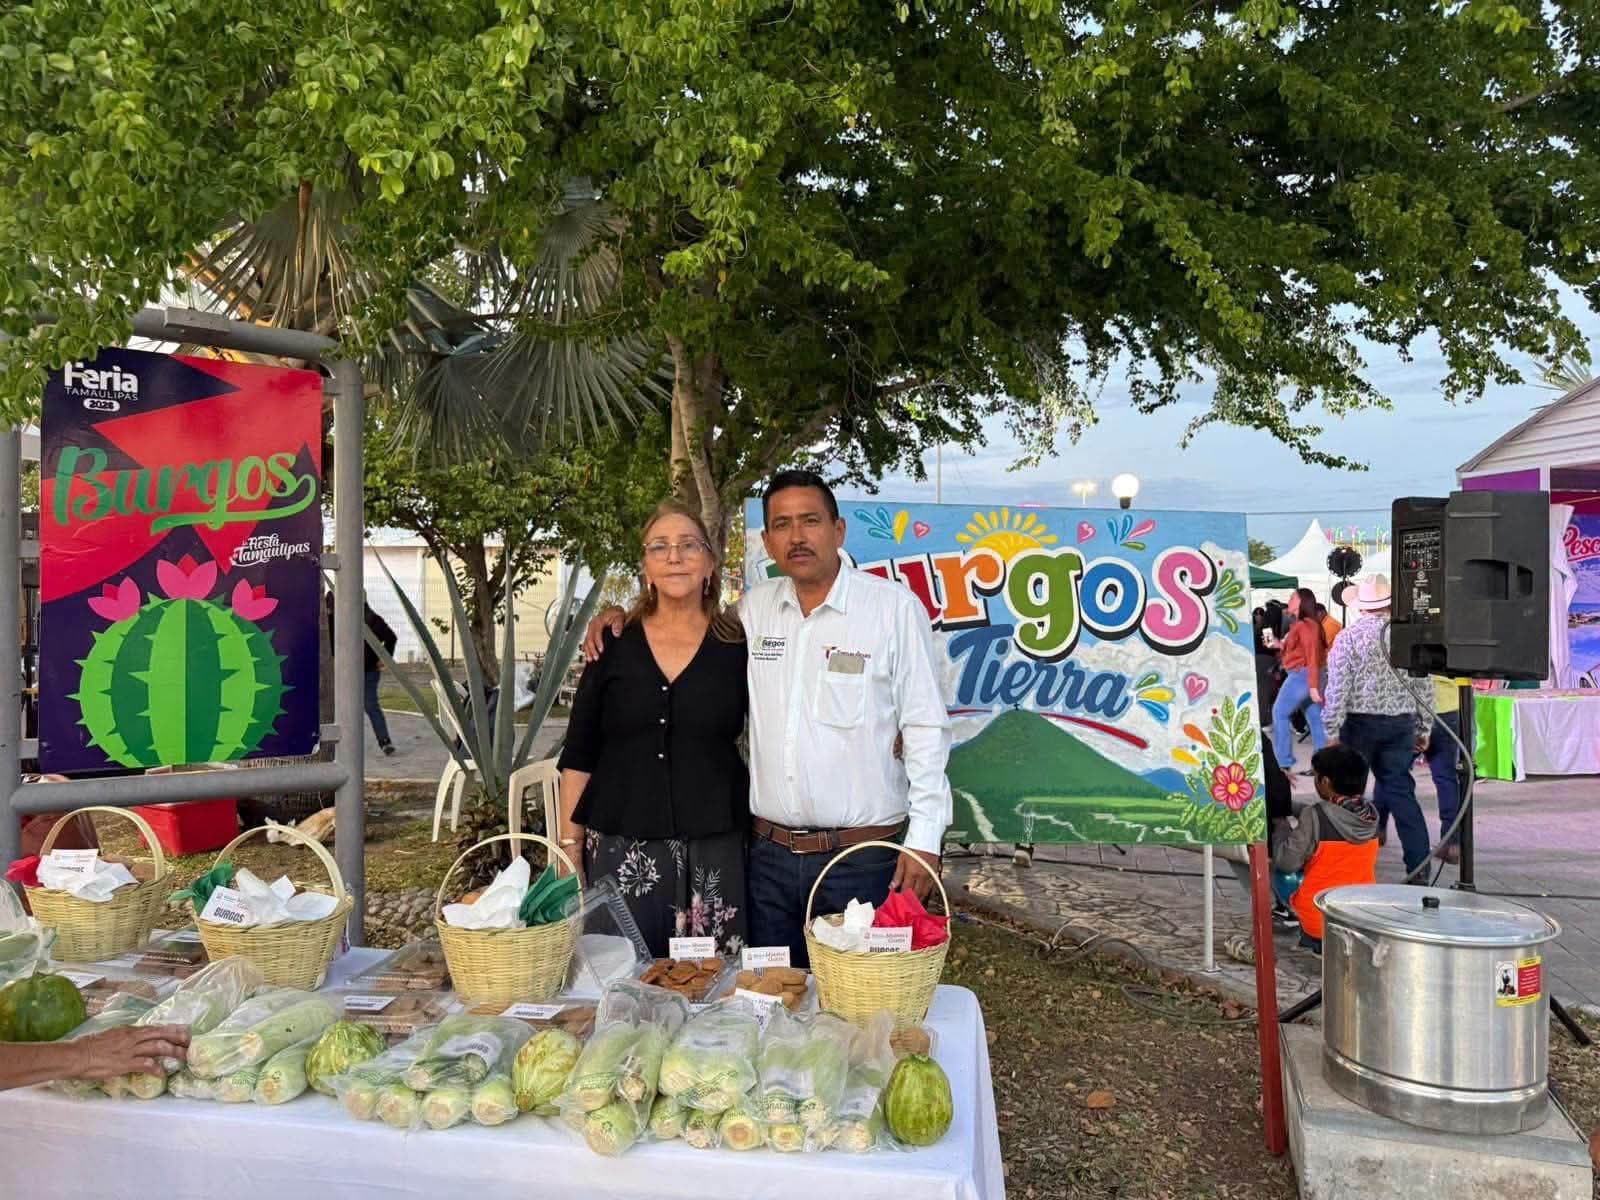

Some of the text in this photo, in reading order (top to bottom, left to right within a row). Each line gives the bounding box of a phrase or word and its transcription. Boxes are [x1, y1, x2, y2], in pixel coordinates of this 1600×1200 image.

[64, 361, 138, 393] Feria
[64, 387, 138, 401] TAMAULIPAS
[52, 446, 316, 536] Burgos
[248, 533, 280, 550] Fiesta
[232, 542, 311, 563] Tamaulipas
[949, 624, 1131, 718] Tierra
[214, 906, 245, 923] BURGOS
